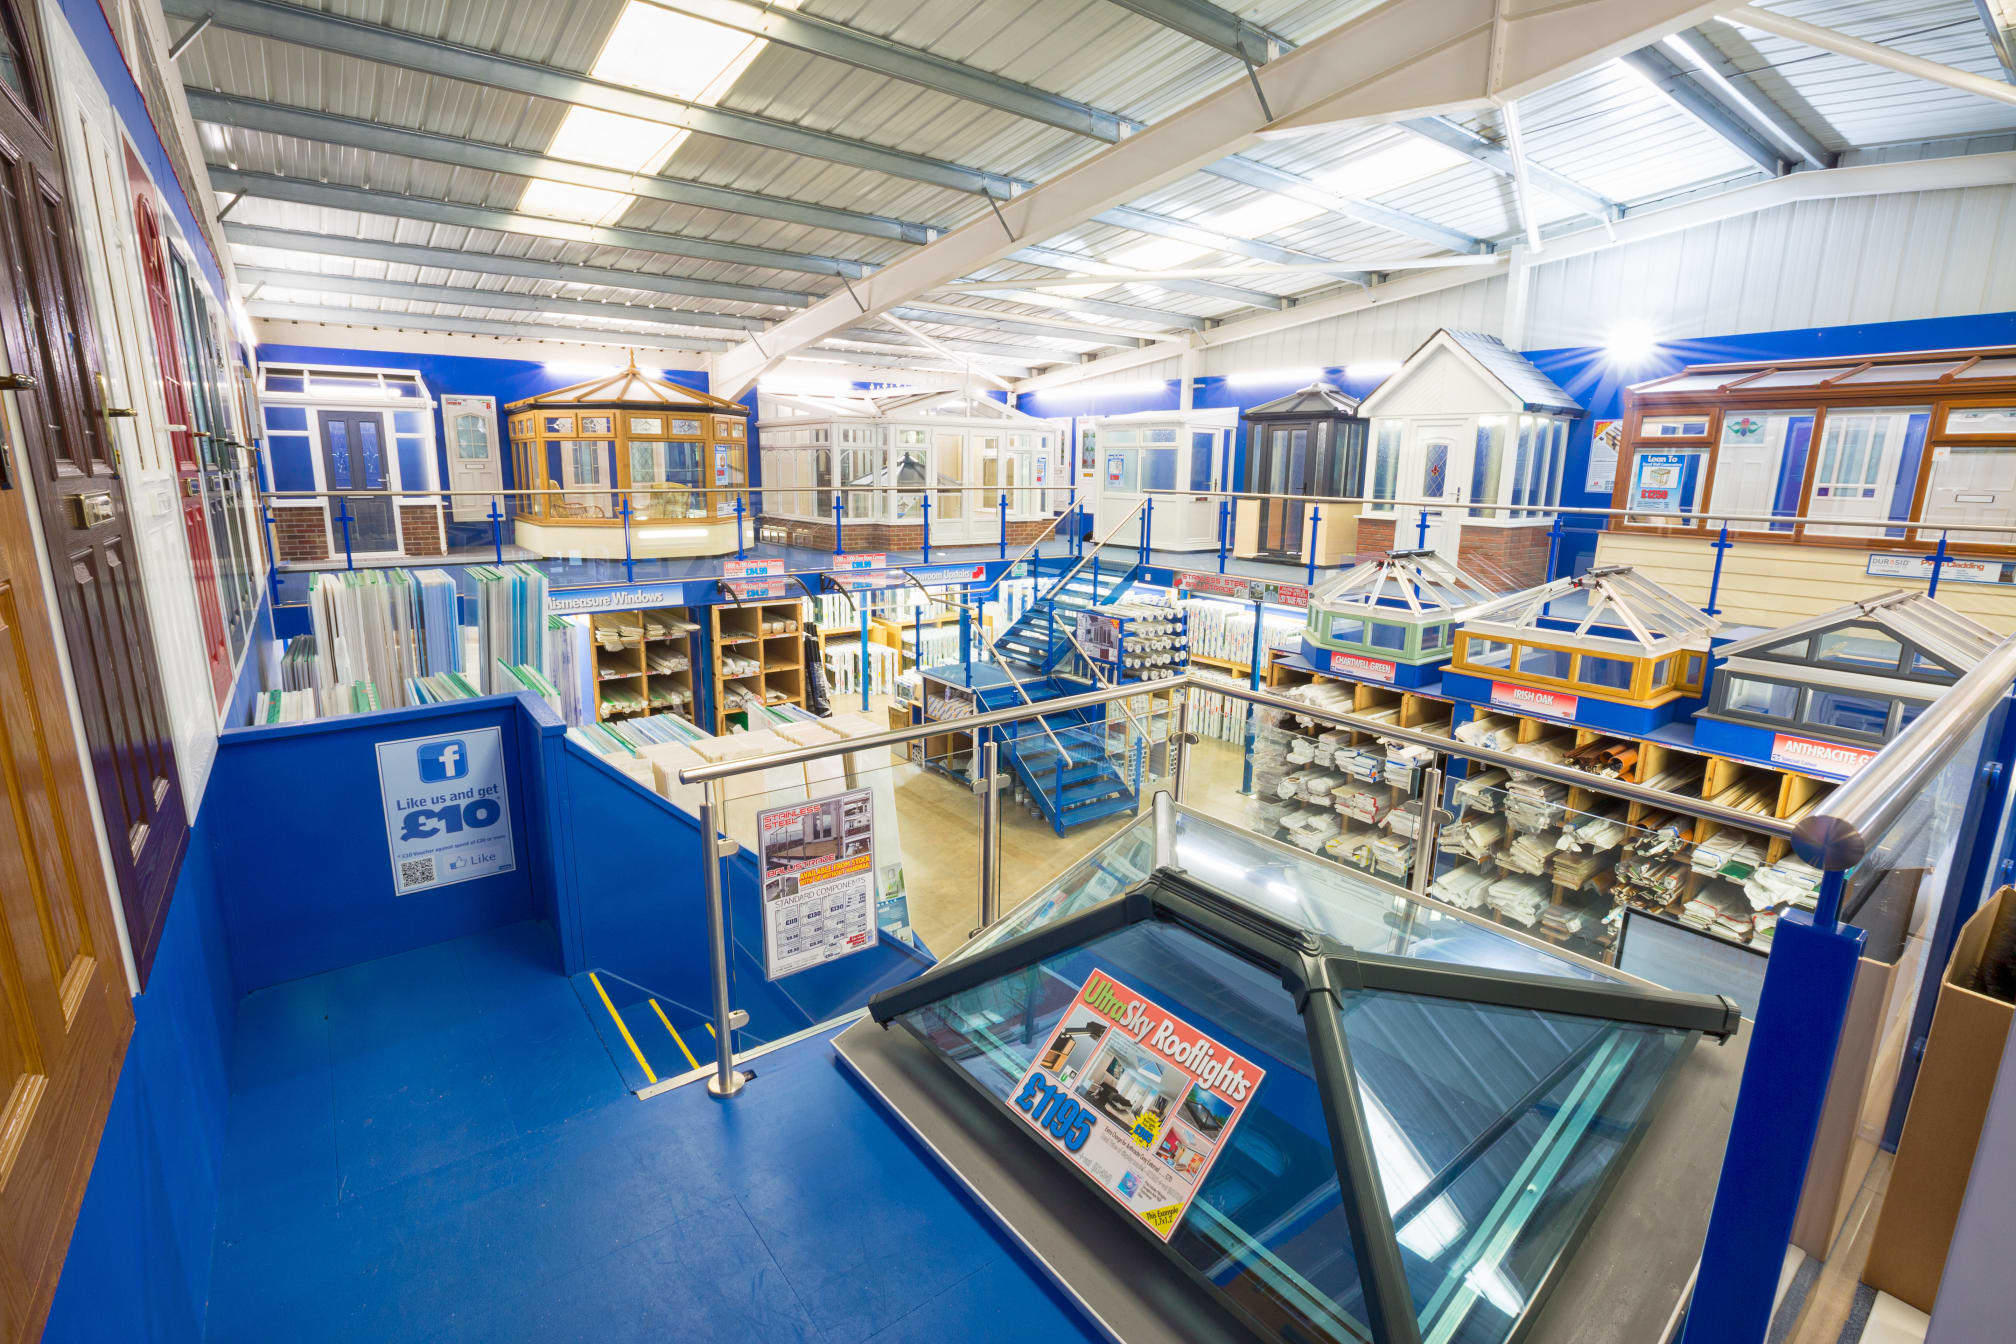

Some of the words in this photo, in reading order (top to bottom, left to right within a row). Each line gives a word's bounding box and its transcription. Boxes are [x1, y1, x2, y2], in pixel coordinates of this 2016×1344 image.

[1640, 489, 1668, 500] £1250
[1946, 562, 1984, 571] Cladding
[1182, 573, 1221, 585] STAINLESS
[1224, 578, 1248, 588] STEEL
[612, 590, 664, 605] Windows
[1336, 656, 1369, 670] CHARTWELL
[1370, 662, 1391, 674] GREEN
[1514, 688, 1535, 703] IRISH
[1536, 693, 1554, 705] OAK
[1784, 740, 1858, 766] ANTHRACITE
[396, 796, 427, 811] Like
[431, 794, 446, 805] us
[450, 788, 474, 802] and
[478, 784, 500, 799] get
[400, 798, 500, 842] £10
[764, 804, 821, 823] STAINLESS
[764, 818, 798, 831] STEEL
[471, 853, 496, 865] Like
[767, 854, 835, 877] BALUSTRADE
[800, 864, 834, 880] AVAILABLE
[834, 860, 850, 871] FROM
[850, 854, 870, 867] STOCK
[775, 891, 814, 908] STANDARD
[816, 878, 866, 894] COMPONENTS
[1084, 974, 1156, 1043] UltraSky
[1151, 1020, 1252, 1102] Rooflights
[1014, 1072, 1096, 1151] £1195
[1146, 1212, 1157, 1220] This
[1157, 1207, 1179, 1218] Example
